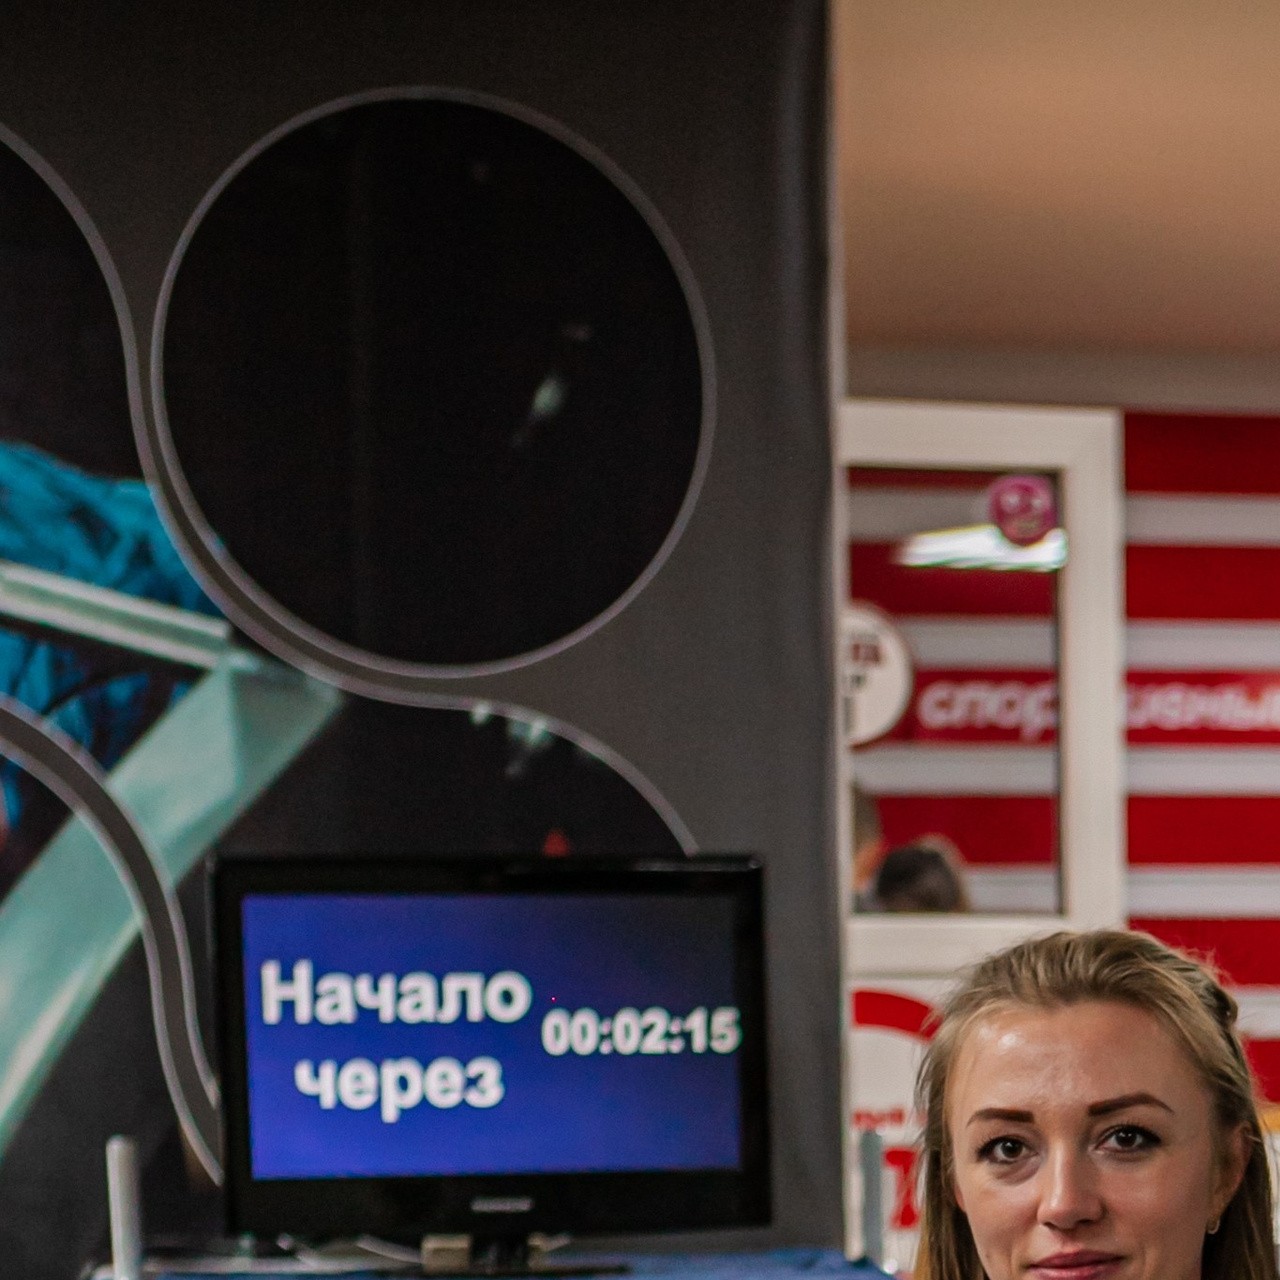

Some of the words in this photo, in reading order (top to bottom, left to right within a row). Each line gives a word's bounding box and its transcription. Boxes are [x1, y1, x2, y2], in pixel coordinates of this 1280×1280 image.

[261, 958, 533, 1025] Начало
[540, 1007, 743, 1056] 00:02:15
[294, 1055, 505, 1123] через
